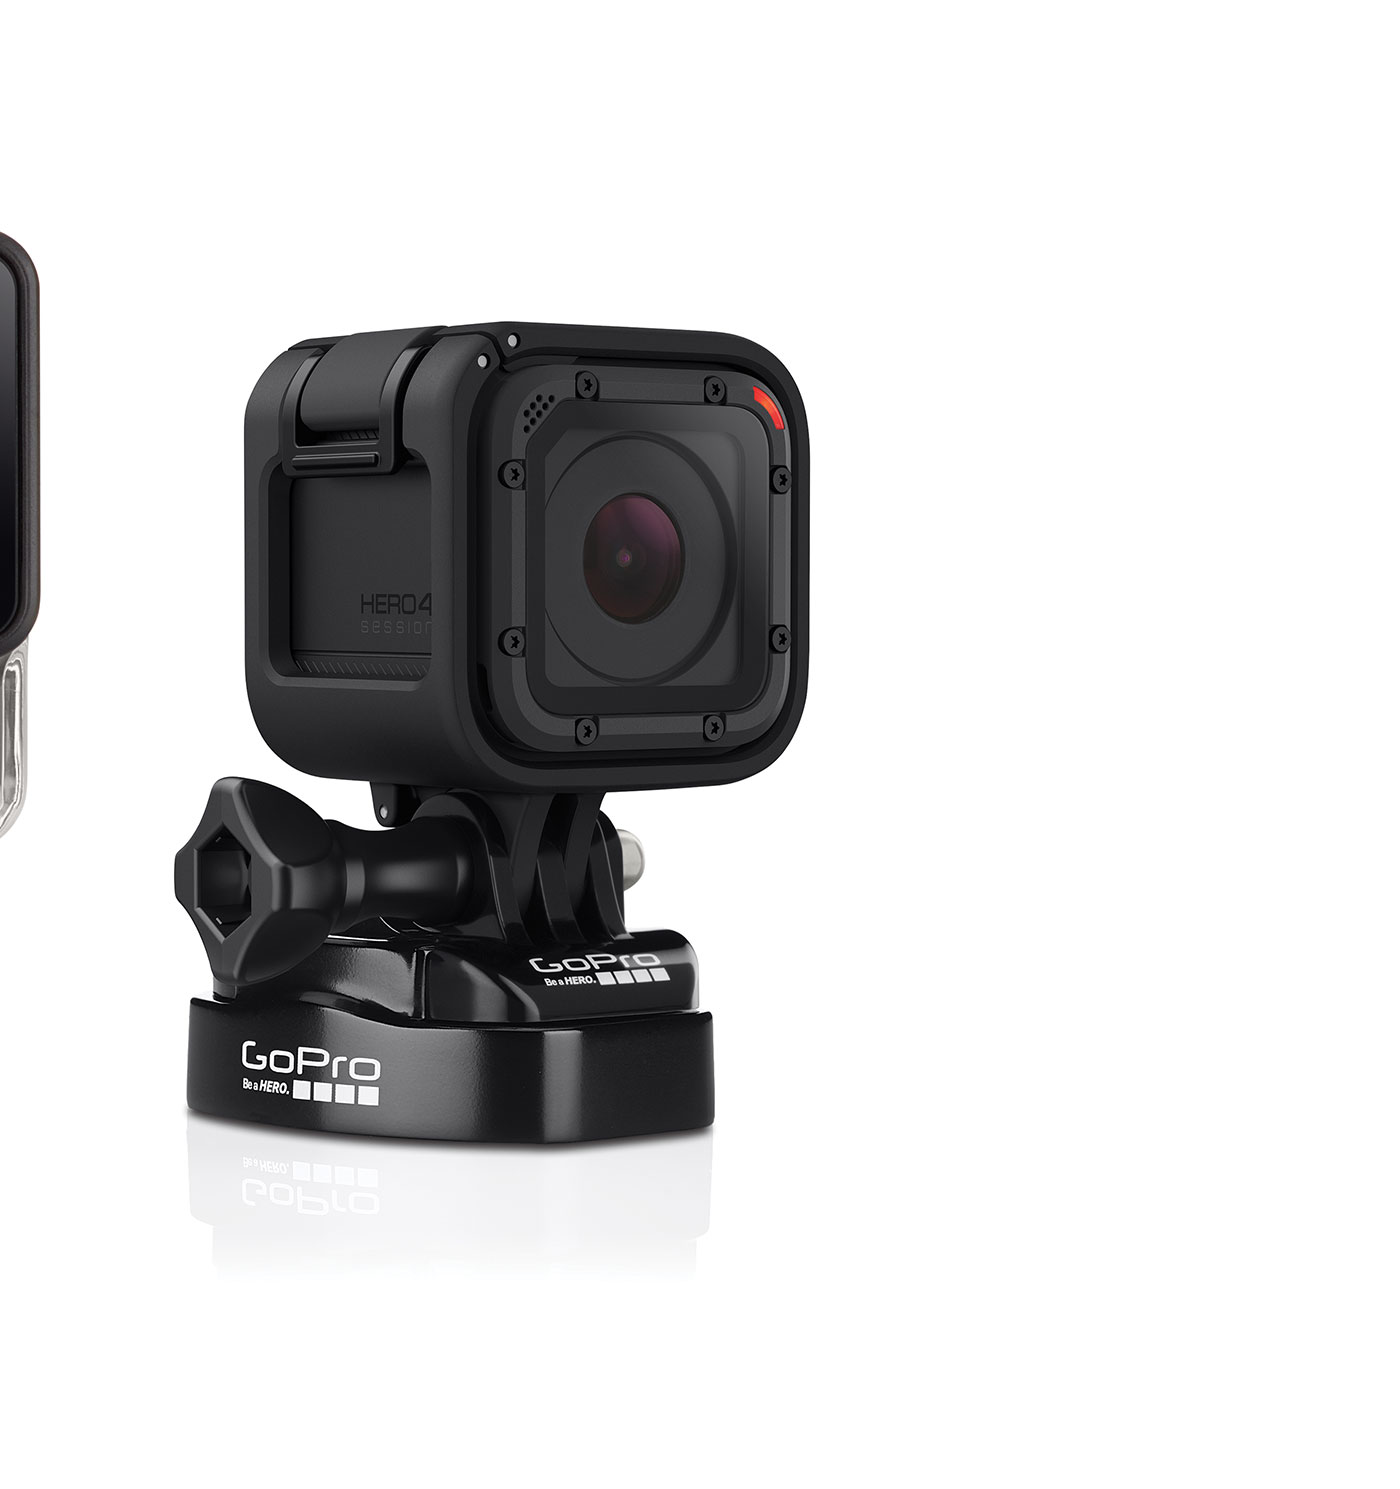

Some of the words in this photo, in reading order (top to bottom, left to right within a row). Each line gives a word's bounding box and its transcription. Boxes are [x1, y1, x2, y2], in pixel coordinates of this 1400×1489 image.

[360, 592, 432, 616] HERO4
[528, 953, 661, 973] GoPro
[544, 978, 558, 987] Be
[241, 1040, 381, 1081] GoPro
[242, 1077, 253, 1091] Be
